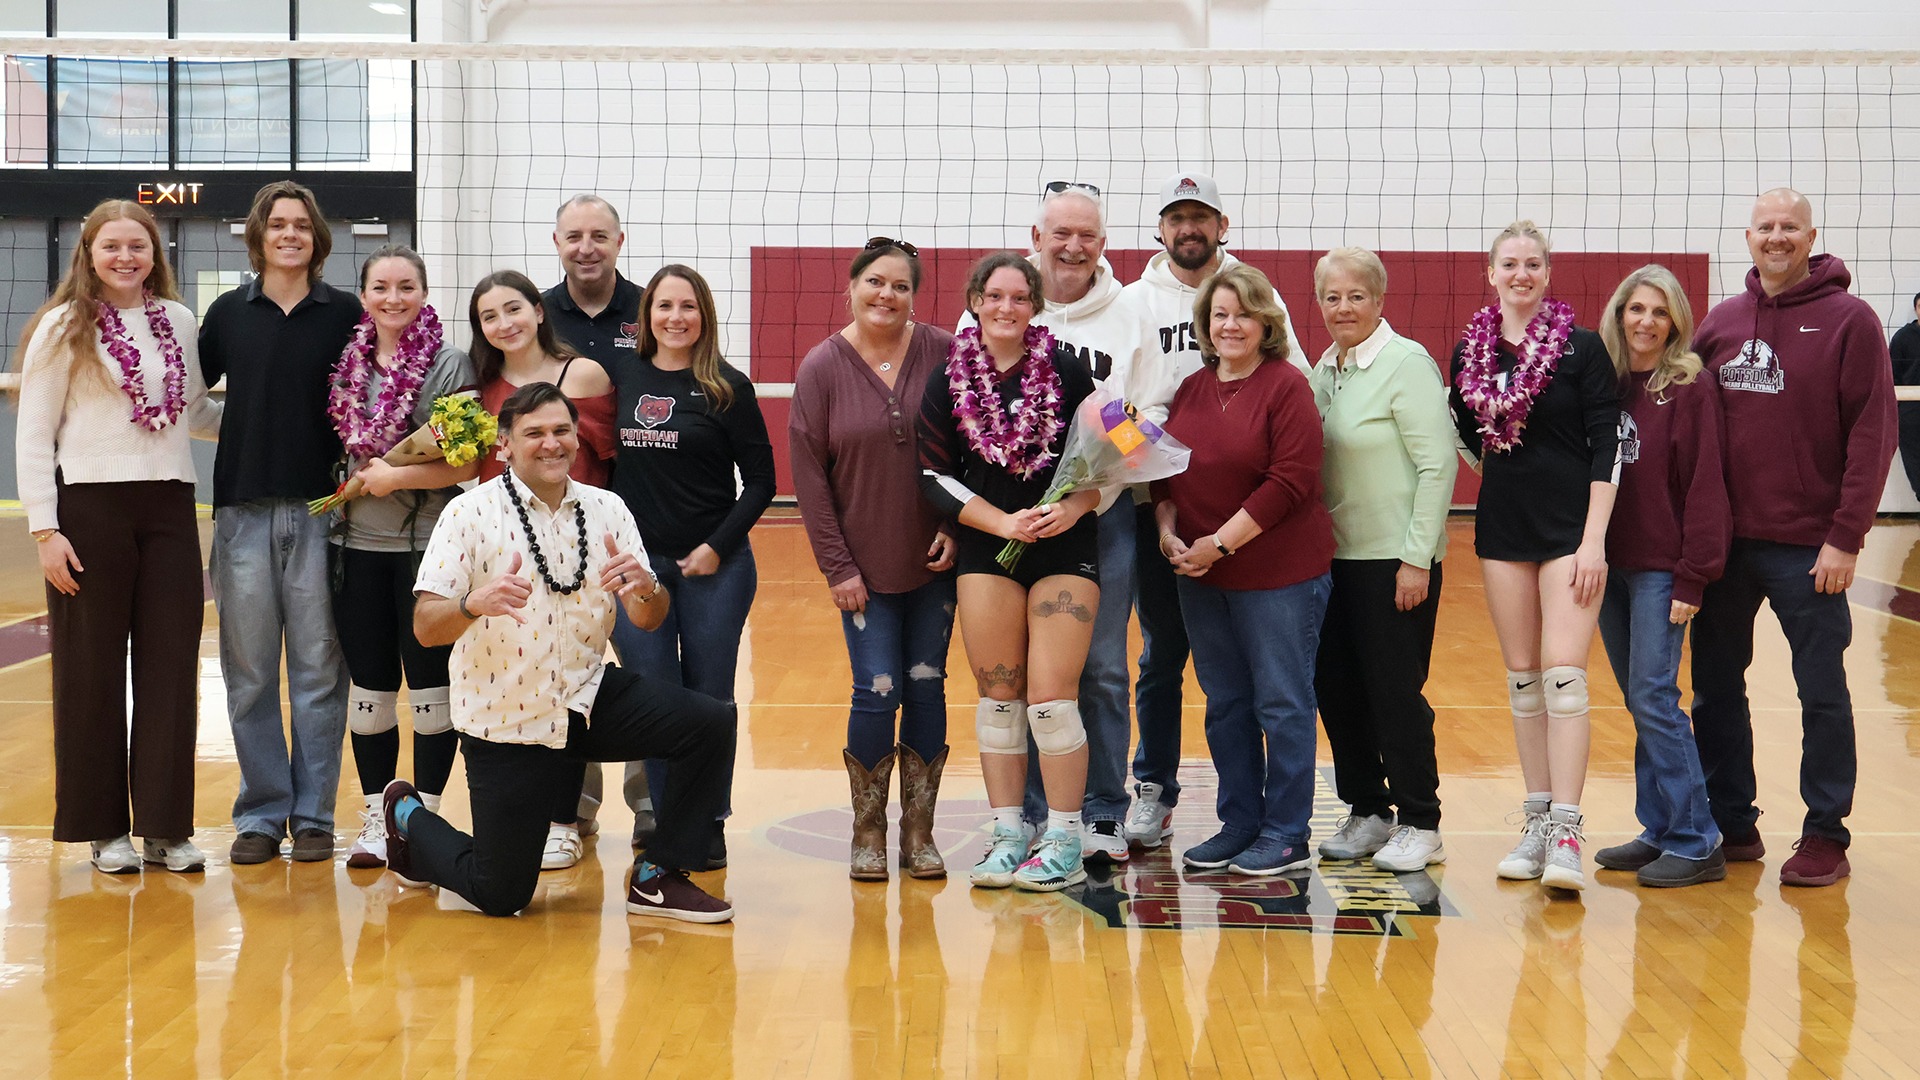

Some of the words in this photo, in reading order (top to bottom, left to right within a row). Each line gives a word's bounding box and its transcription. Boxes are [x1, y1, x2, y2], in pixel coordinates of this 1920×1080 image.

[138, 182, 204, 204] EXIT
[1720, 367, 1783, 389] POTSDAM
[620, 428, 679, 442] POTSDAM
[622, 440, 678, 450] VOLLEYBALL
